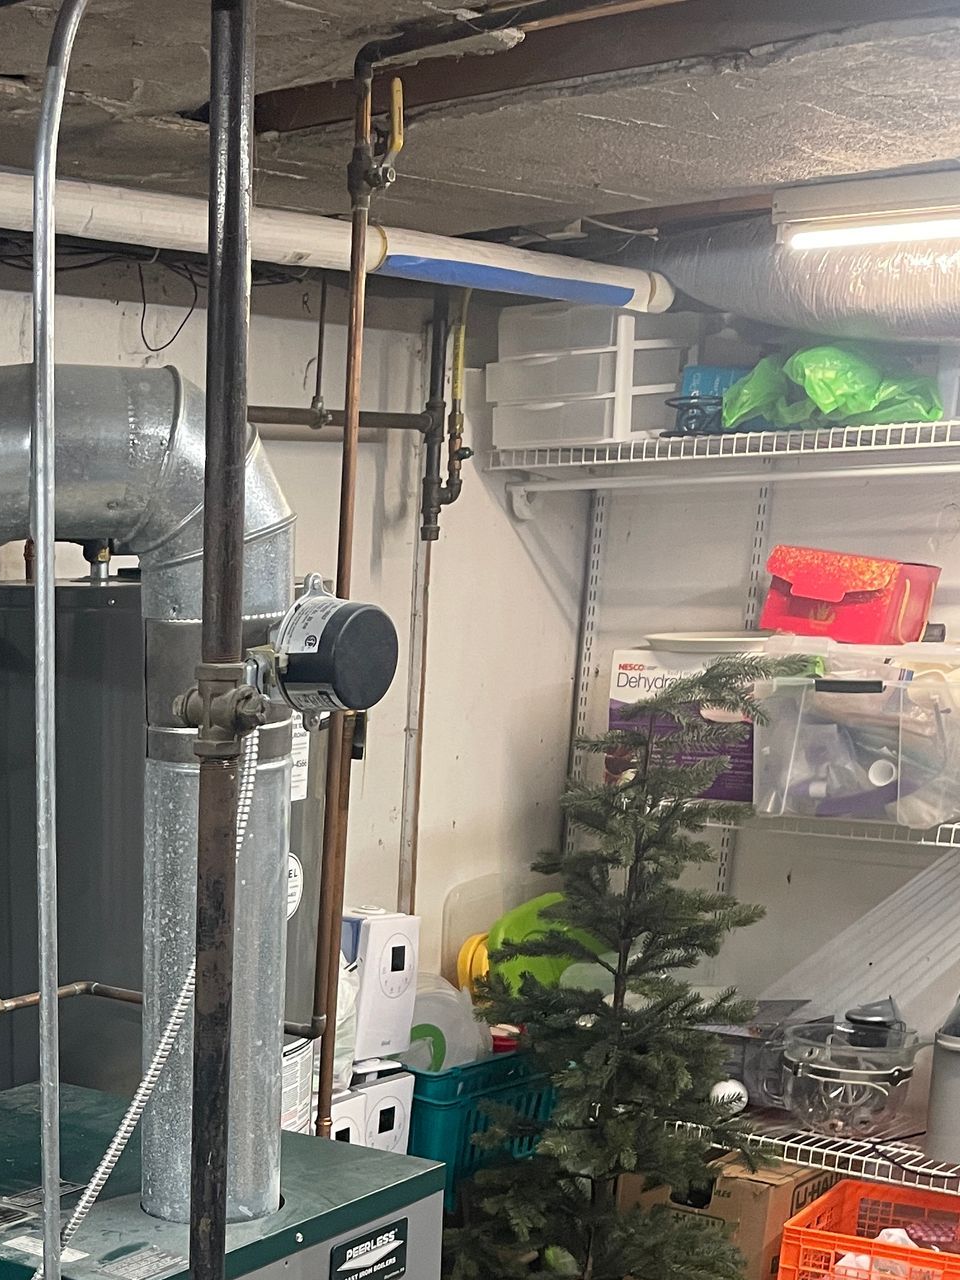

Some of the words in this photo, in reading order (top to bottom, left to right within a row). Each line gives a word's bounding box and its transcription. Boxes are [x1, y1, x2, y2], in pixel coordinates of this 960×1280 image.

[618, 663, 644, 671] NESCO
[346, 1230, 396, 1261] PEERLESS
[374, 1256, 396, 1272] BOILERS
